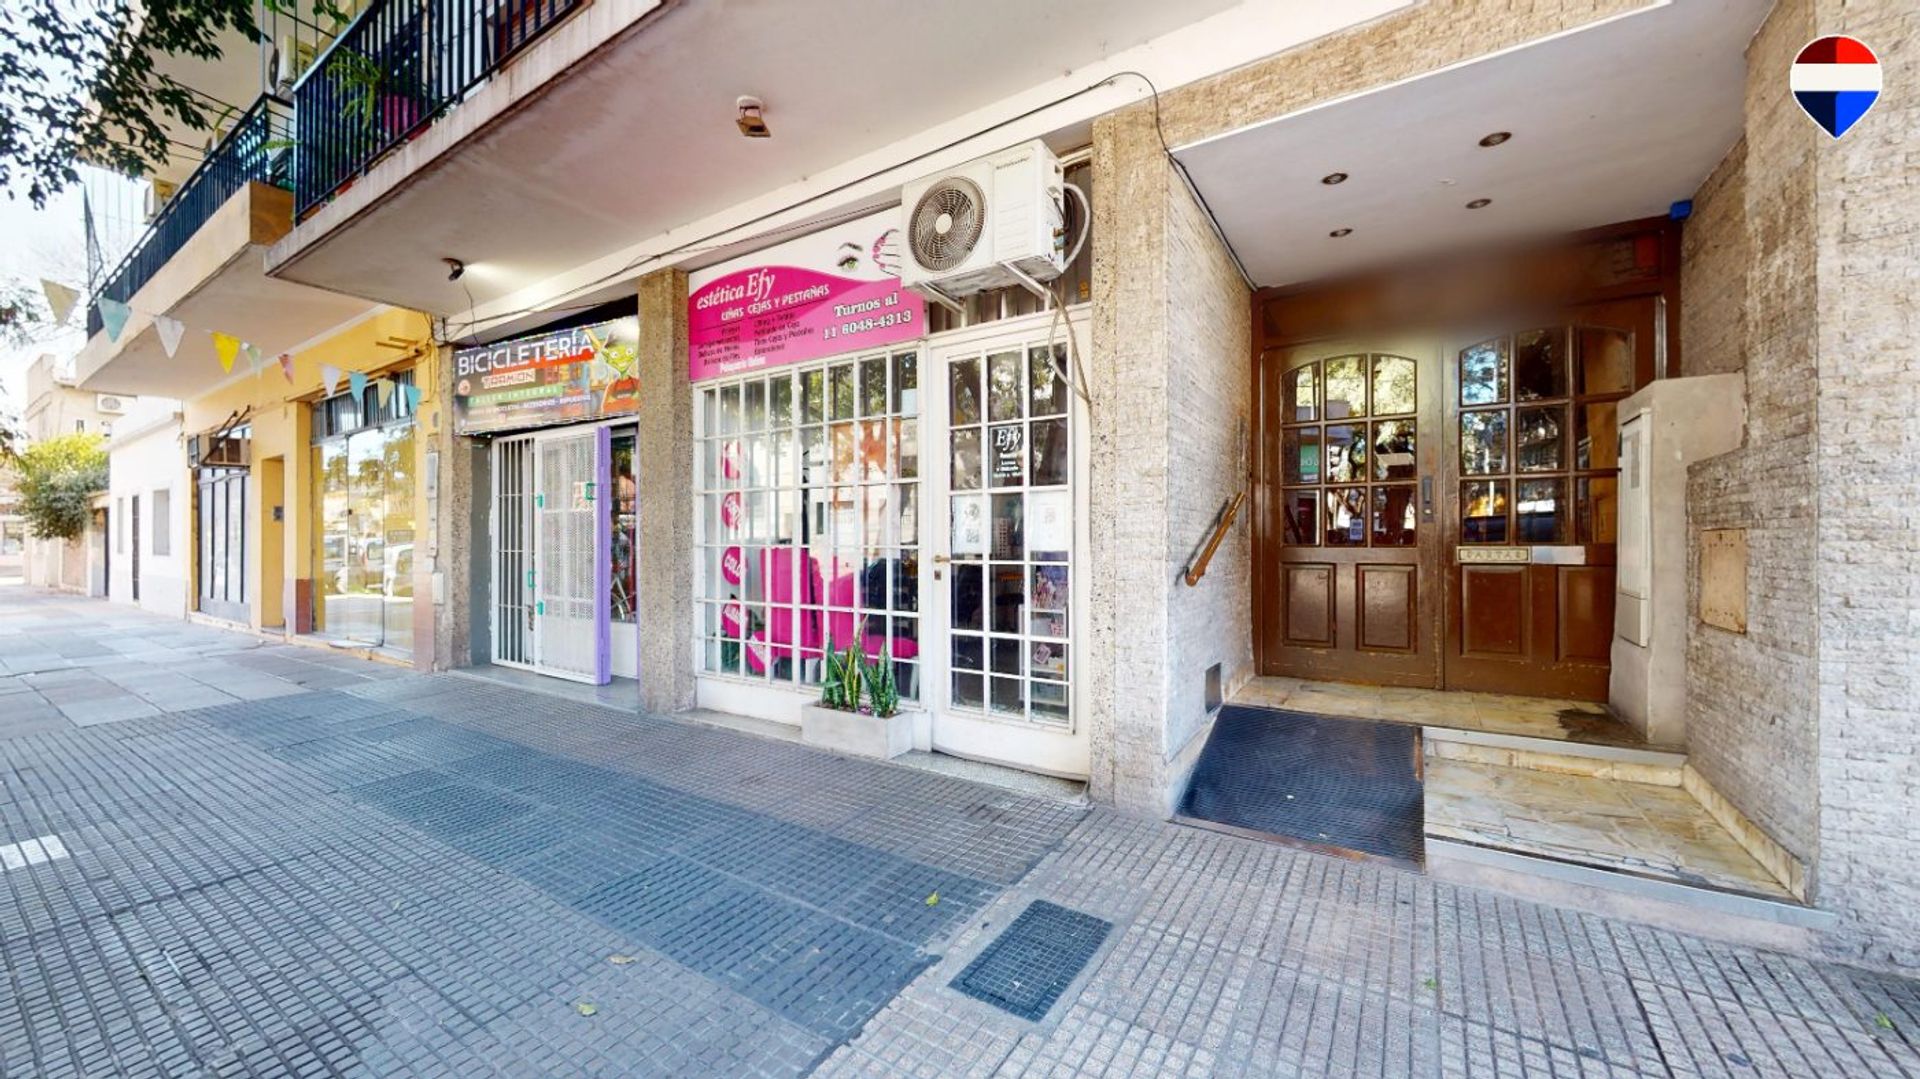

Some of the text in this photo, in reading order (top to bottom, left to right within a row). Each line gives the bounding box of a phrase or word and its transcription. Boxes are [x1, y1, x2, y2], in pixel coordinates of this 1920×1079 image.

[697, 268, 776, 310] estética Efy
[747, 301, 772, 316] CEJAS
[774, 299, 782, 309] Y
[782, 284, 830, 306] PESTAÑAS
[833, 293, 899, 317] Turnos al
[823, 310, 913, 341] 11 6048-4313
[458, 331, 595, 376] BICICLETERÍA
[995, 427, 1022, 451] Efy
